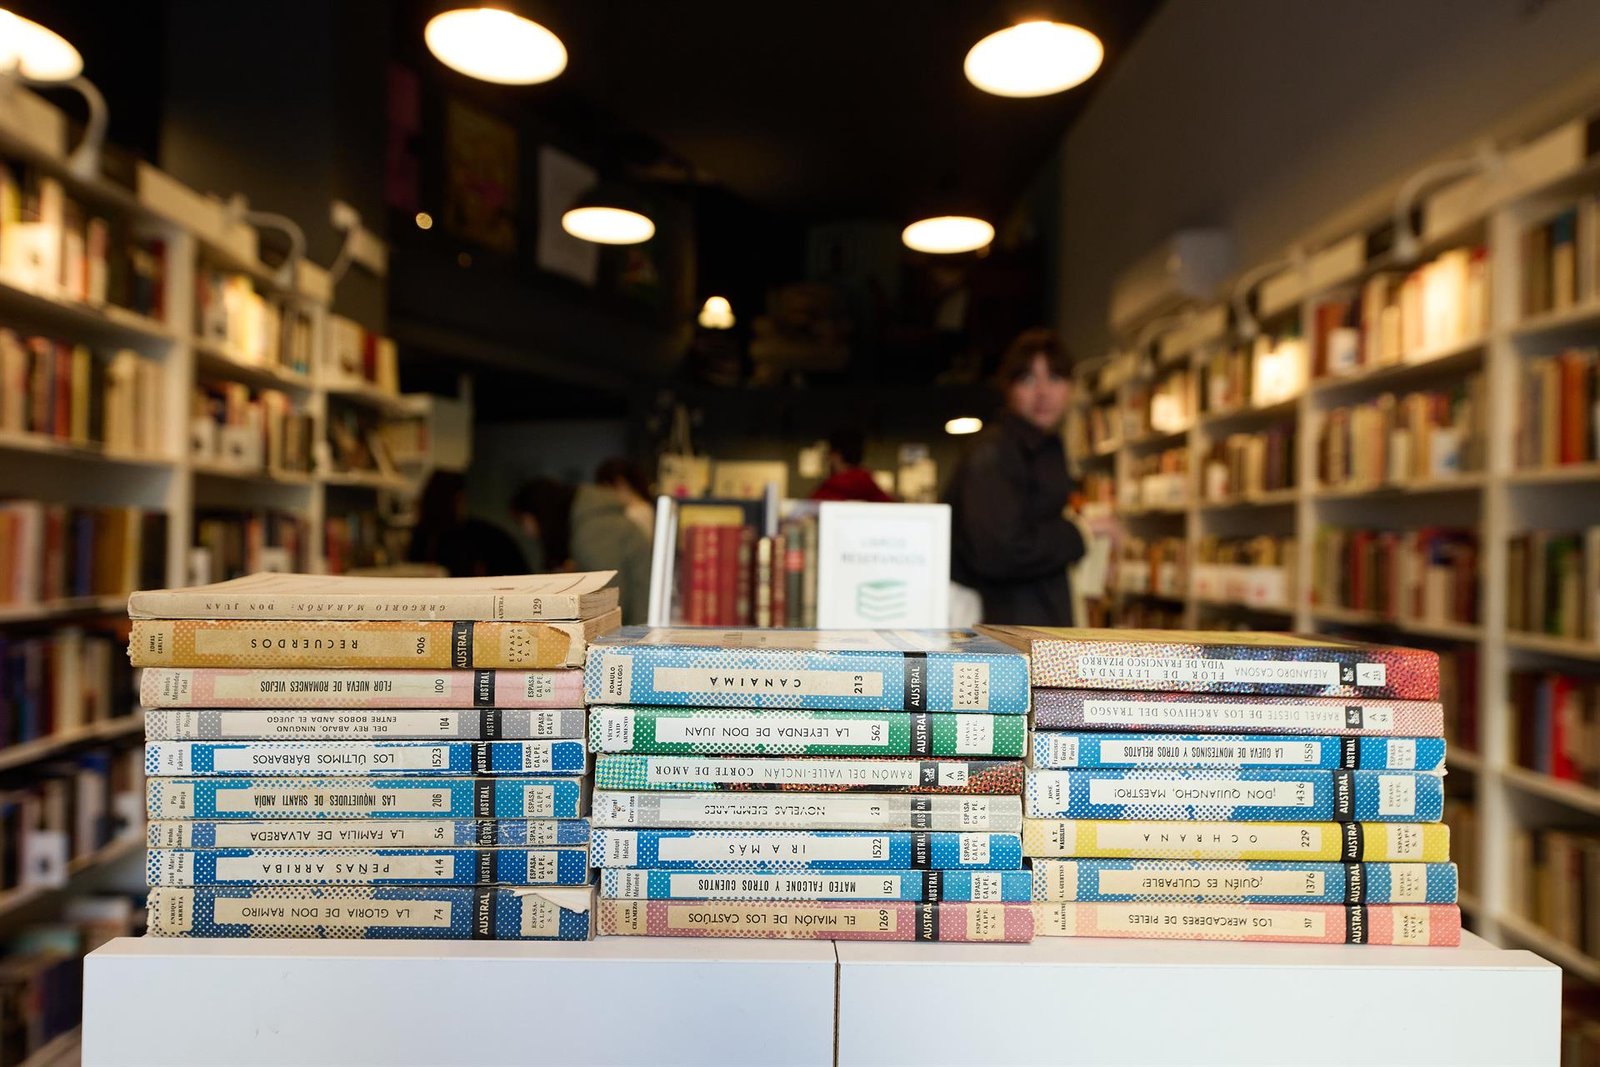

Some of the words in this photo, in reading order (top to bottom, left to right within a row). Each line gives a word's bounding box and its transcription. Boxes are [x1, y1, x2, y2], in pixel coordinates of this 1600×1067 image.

[205, 603, 240, 611] JUAN
[248, 603, 274, 611] DON
[375, 604, 446, 612] GREGORIO
[532, 598, 543, 616] 129
[250, 639, 358, 649] RECUERDOS
[416, 636, 426, 655] 906
[456, 629, 468, 668] AUSTRAL
[1082, 657, 1124, 667] PIZARRO
[1127, 658, 1182, 668] FRANCISCO
[1184, 660, 1197, 669] DE
[1200, 660, 1224, 669] VIDA
[1082, 668, 1150, 678] LEYENDAS
[1163, 670, 1178, 679] DE
[1192, 671, 1224, 680] FLOR
[1234, 667, 1273, 678] CASONA
[1277, 669, 1328, 679] ALEJANDRO
[260, 681, 286, 692] VIEJOS
[290, 681, 329, 692] ROMANCES
[333, 681, 342, 692] DE
[346, 681, 370, 692] NUEVA
[374, 680, 392, 692] FLOR
[435, 679, 445, 693] 100
[480, 671, 490, 701] AUSTRAL
[709, 677, 801, 688] CANAIMA
[853, 675, 863, 694] 213
[911, 667, 921, 707] AUSTRAL
[1090, 706, 1133, 716] TRASGO
[1138, 708, 1158, 717] DEL
[1162, 708, 1219, 718] ARCHIVOS
[1224, 709, 1244, 718] LOS
[1248, 710, 1262, 719] DE
[1267, 710, 1299, 720] DIESTE
[1304, 711, 1340, 721] RAFAEL
[439, 717, 449, 730] 104
[685, 727, 716, 737] JUAN
[722, 727, 749, 737] DON
[755, 727, 770, 737] DE
[777, 727, 828, 737] LEYENDA
[835, 728, 850, 738] LA
[871, 724, 881, 741] 562
[916, 713, 927, 753] AUSTRAL
[1124, 746, 1154, 757] RELATOS
[1157, 747, 1180, 757] OTROS
[1183, 747, 1188, 757] Y
[1191, 747, 1234, 757] MONTESINOS
[1237, 748, 1246, 758] DE
[1250, 748, 1272, 758] CUEVA
[1274, 748, 1283, 758] LA
[1304, 743, 1313, 762] 1558
[252, 754, 310, 765] BÁRBAROS
[317, 754, 366, 765] ÚLTIMOS
[373, 754, 394, 764] LOS
[432, 748, 442, 768] 1523
[655, 766, 690, 776] AMOR
[694, 766, 709, 776] DE
[715, 766, 754, 777] CORTE
[763, 768, 842, 779] VALLE-INCLÁN
[848, 769, 866, 779] DEL
[871, 769, 912, 781] RAMÓN
[1114, 788, 1166, 799] MAESTRO!
[1296, 784, 1305, 806] 1436
[1340, 773, 1349, 814] AUSTRAL
[254, 795, 276, 808] ANDÍA
[282, 795, 308, 806] SHANTI
[314, 795, 324, 806] DE
[329, 795, 376, 806] INQUIETUDES
[382, 795, 396, 806] LAS
[432, 794, 442, 807] 206
[480, 786, 490, 816] AUSTRAL
[250, 831, 311, 841] ALVAREDA
[317, 831, 332, 840] DE
[339, 830, 383, 840] FAMILIA
[390, 830, 405, 839] LA
[434, 827, 444, 839] 56
[1143, 832, 1258, 844] OCHRANA
[1302, 830, 1310, 848] 229
[728, 844, 760, 858] MÁS
[771, 845, 780, 854] A
[791, 845, 806, 854] IR
[873, 838, 882, 858] 1522
[916, 832, 926, 865] AUSTRAL
[262, 864, 324, 874] ARRIBA
[335, 864, 390, 874] PEÑAS
[435, 858, 444, 876] 414
[481, 852, 491, 883] AUSTRAL
[698, 880, 736, 891] CUENTOS
[741, 880, 769, 891] OTROS
[775, 881, 780, 891] Y
[786, 880, 823, 892] FALCONE
[828, 881, 855, 892] MATEO
[883, 880, 892, 894] 152
[928, 871, 937, 901] AUSTRAL
[1142, 878, 1200, 888] CULPABLE?
[1206, 879, 1218, 888] ES
[1224, 877, 1263, 890] ¿QUIÉN
[1306, 873, 1315, 893] 1376
[1350, 864, 1360, 902] AUSTRAL
[241, 907, 284, 918] RAMIRO
[291, 908, 318, 918] DON
[325, 908, 340, 918] DE
[347, 908, 389, 918] GLORIA
[396, 909, 410, 918] LA
[434, 909, 444, 920] 74
[479, 892, 490, 935] AUSTRAL
[688, 913, 739, 925] CASTÚOS
[746, 914, 767, 924] LOS
[773, 914, 788, 924] DE
[794, 914, 836, 926] MIAJÓN
[844, 915, 856, 925] EL
[879, 909, 889, 931] 1269
[923, 902, 932, 939] AUSTRAL
[1128, 915, 1159, 924] PIELES
[1164, 916, 1177, 925] DE
[1183, 916, 1247, 926] MERCADERES
[1252, 918, 1272, 927] LOS
[1350, 905, 1362, 943] AUSTRAL
